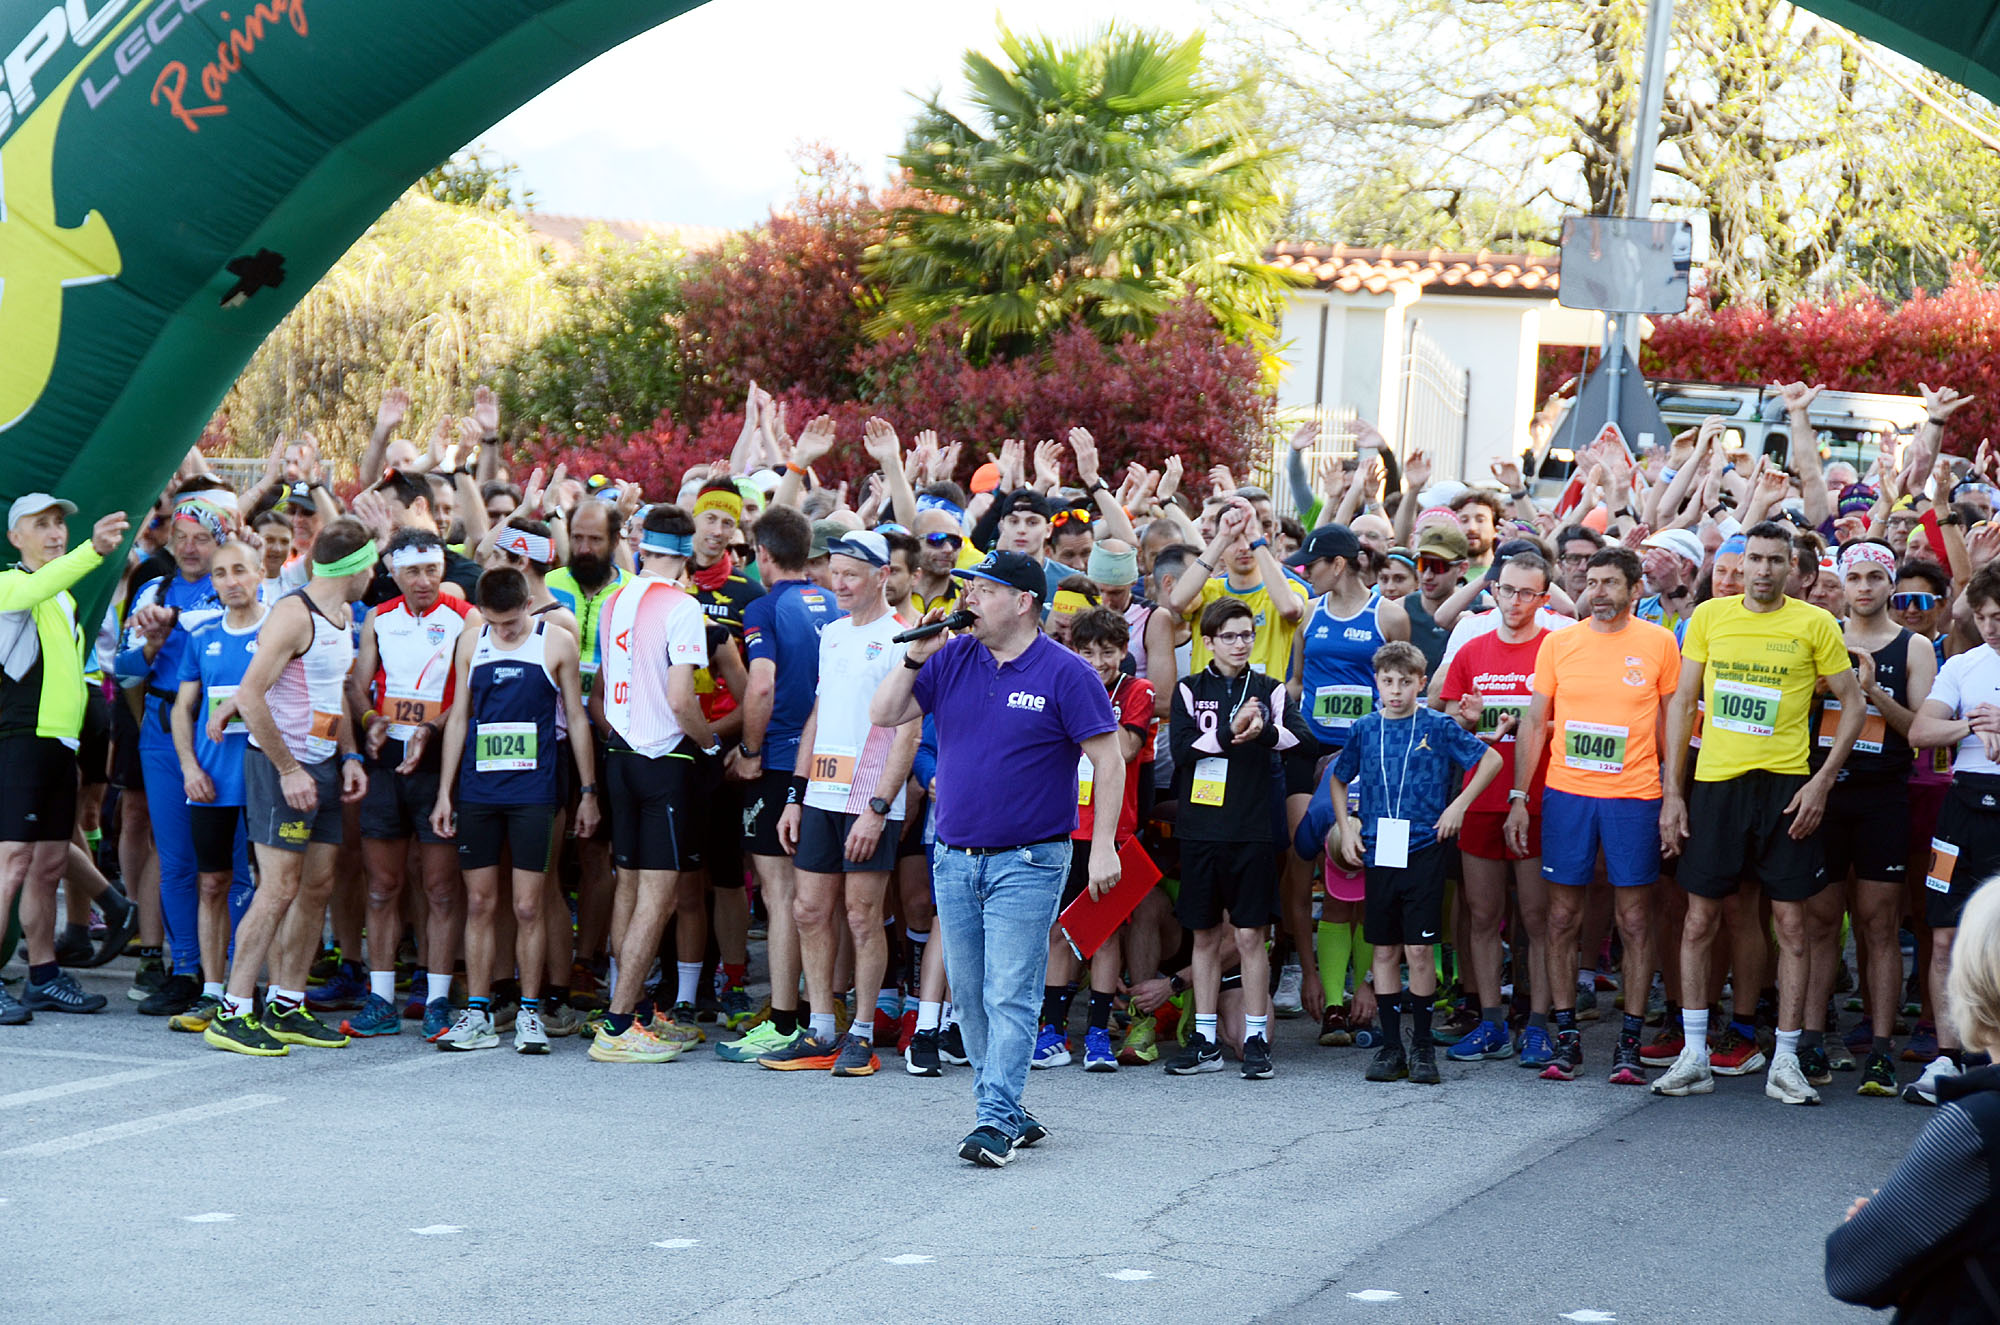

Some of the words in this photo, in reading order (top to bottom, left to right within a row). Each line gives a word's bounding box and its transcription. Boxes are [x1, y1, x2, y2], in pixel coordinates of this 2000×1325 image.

[511, 537, 529, 551] A
[1343, 627, 1373, 641] AVIS
[1007, 690, 1046, 709] cine
[1323, 696, 1363, 715] 1028
[1721, 694, 1768, 721] 1095
[394, 700, 425, 722] 129
[1194, 709, 1218, 733] 10
[484, 735, 525, 756] 1024
[1573, 734, 1616, 758] 1040
[816, 757, 838, 779] 116
